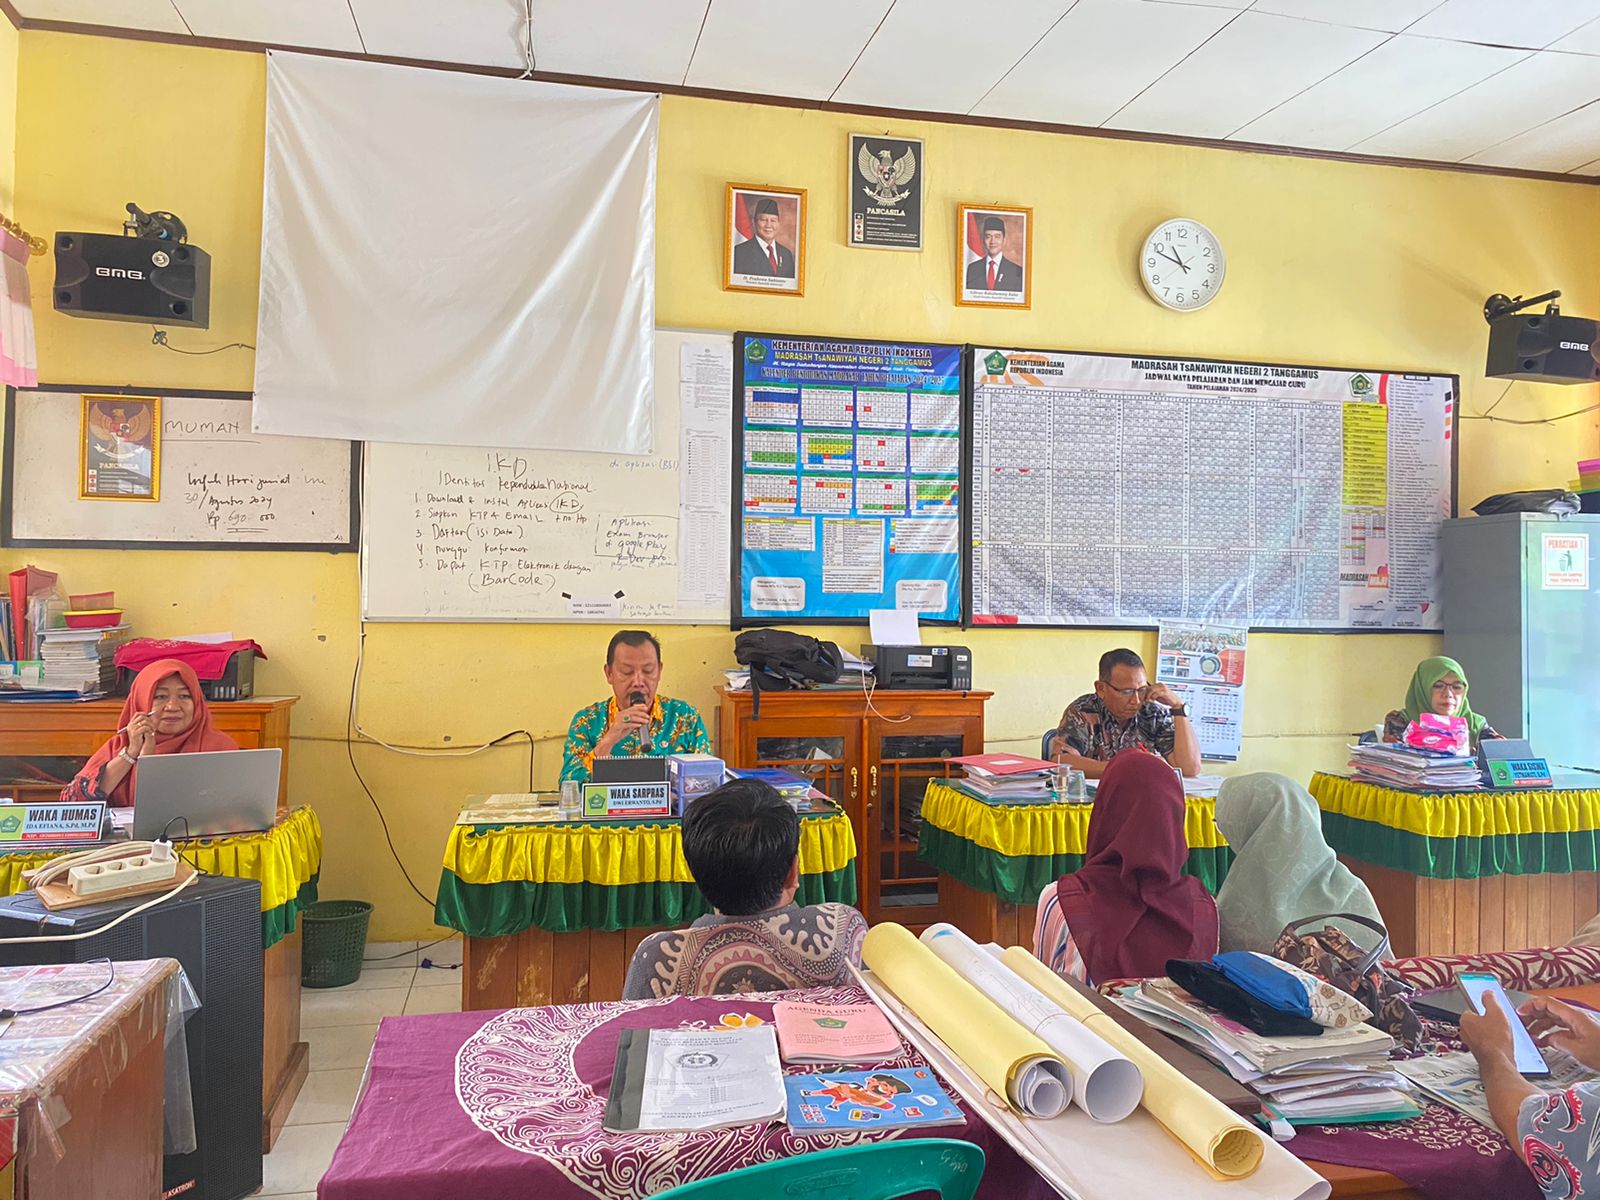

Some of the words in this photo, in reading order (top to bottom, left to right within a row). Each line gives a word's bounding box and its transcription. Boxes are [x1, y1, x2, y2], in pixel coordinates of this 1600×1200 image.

[867, 208, 905, 216] PANCASILA
[1165, 232, 1171, 241] 11
[1178, 228, 1188, 239] 12
[1195, 234, 1199, 244] 1
[1154, 242, 1164, 253] 10
[1203, 247, 1211, 257] 2
[1148, 257, 1156, 268] 9
[1207, 263, 1215, 273] 3
[1152, 274, 1160, 285] 8
[1202, 279, 1209, 289] 4
[1163, 286, 1170, 297] 7
[1192, 290, 1200, 300] 5
[1176, 292, 1184, 303] 6
[772, 340, 825, 351] KEMENTERIAN
[826, 343, 853, 353] AGAMA
[855, 345, 891, 356] REPUBLIK
[893, 348, 932, 358] INDONESIA
[775, 352, 813, 361] MADRASAH
[860, 355, 884, 364] NEGERI
[885, 357, 890, 365] 2
[891, 358, 932, 367] TANGGAMUS
[1010, 359, 1046, 368] KEMENTERIAN
[1010, 367, 1035, 375] REPUBLIK
[1036, 368, 1064, 376] INDONESIA
[1131, 360, 1178, 371] MADRASAH
[1179, 362, 1232, 374] TsANAWIYAH
[1234, 366, 1262, 376] NEGERI
[1263, 367, 1269, 377] 2
[1271, 368, 1319, 379] TANGGAMUS
[1144, 373, 1172, 381] JADWAL
[1173, 374, 1191, 382] MATA
[1192, 375, 1227, 384] PELAJARAN
[1228, 377, 1240, 385] DAN
[1241, 377, 1254, 386] JAM
[1255, 378, 1287, 387] MENGAJAR
[1288, 380, 1306, 388] GURU
[611, 788, 630, 799] WAKA
[632, 787, 665, 798] SARPRAS
[29, 809, 58, 822] WAKA
[61, 808, 97, 821] HUMAS
[26, 822, 38, 830] IDA
